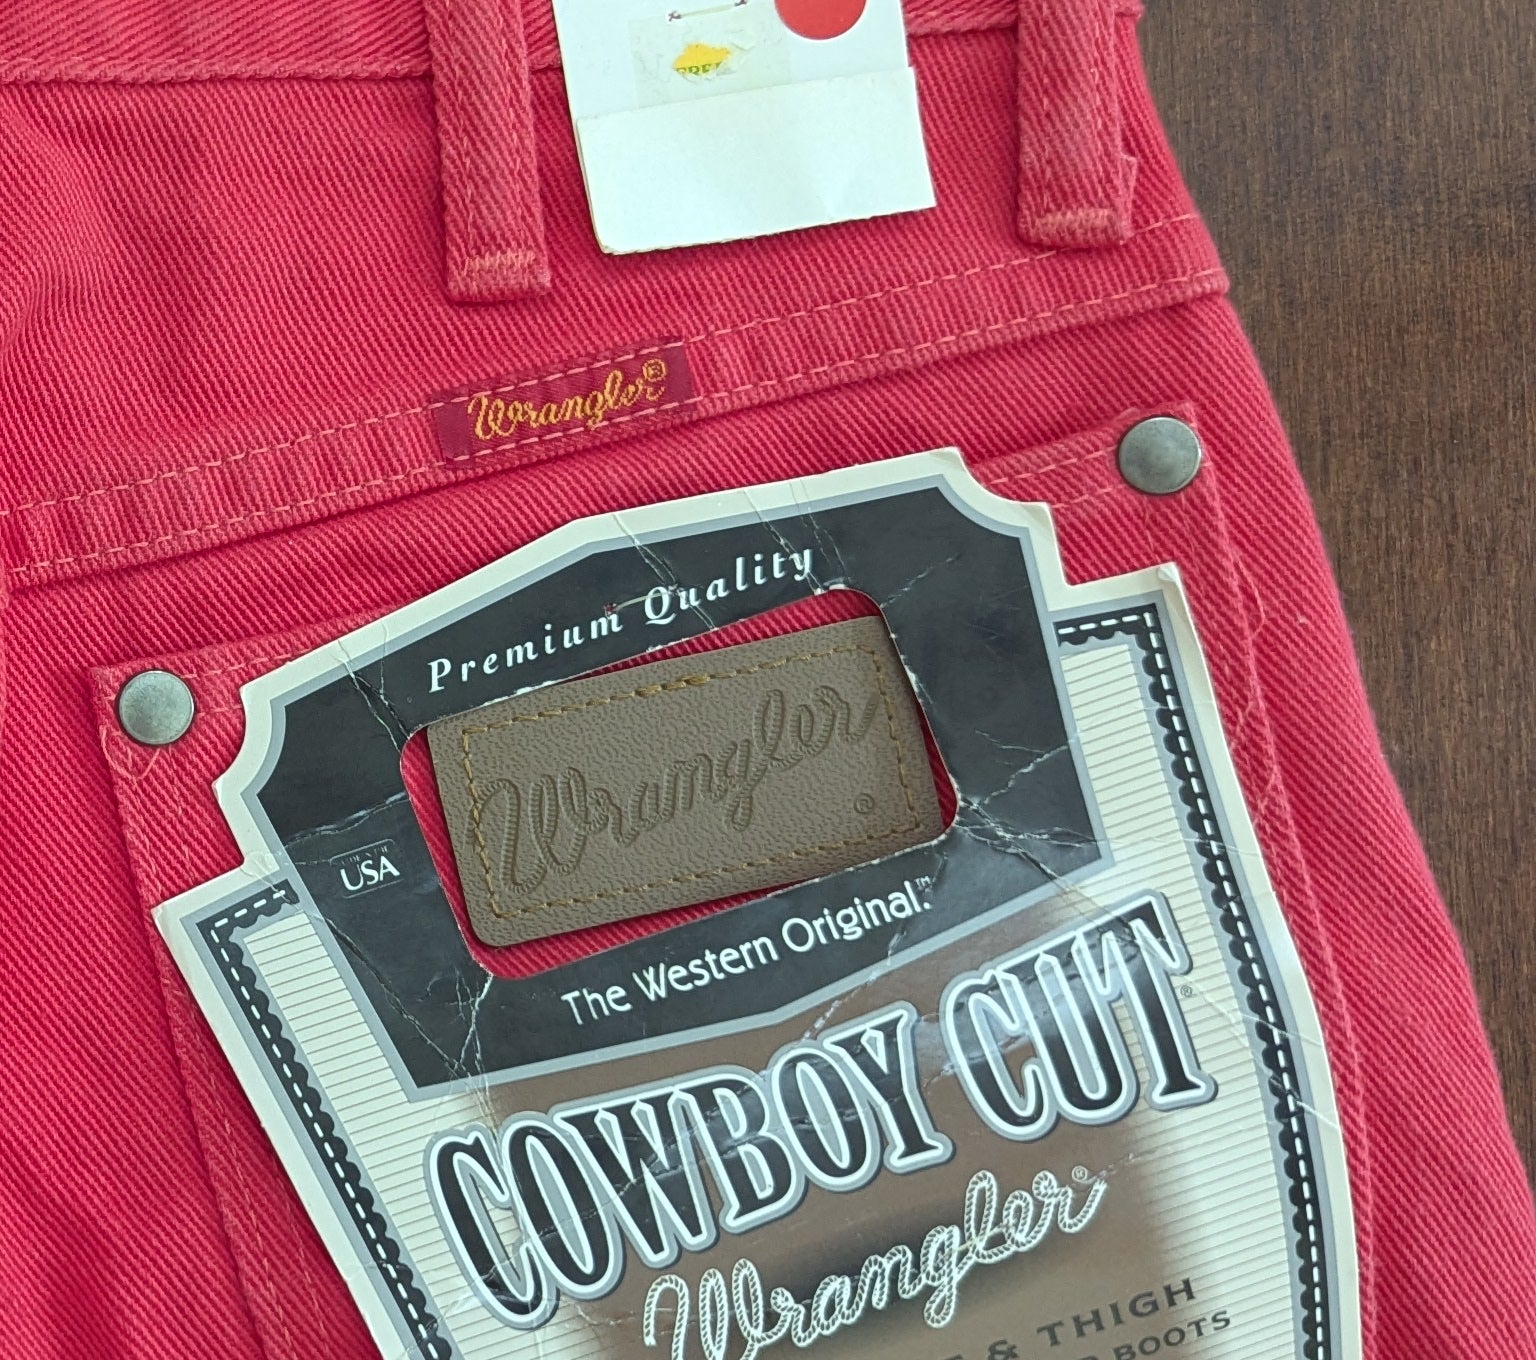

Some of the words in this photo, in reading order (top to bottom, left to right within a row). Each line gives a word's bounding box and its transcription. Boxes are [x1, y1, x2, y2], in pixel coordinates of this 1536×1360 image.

[427, 612, 623, 693] Premium
[644, 548, 814, 625] Quality
[474, 685, 882, 893] Wrangler
[340, 855, 401, 891] USA
[560, 983, 633, 1026] The
[632, 936, 780, 1002] Western
[427, 1001, 954, 1329] COWBOY
[1036, 1277, 1196, 1347] THIGH
